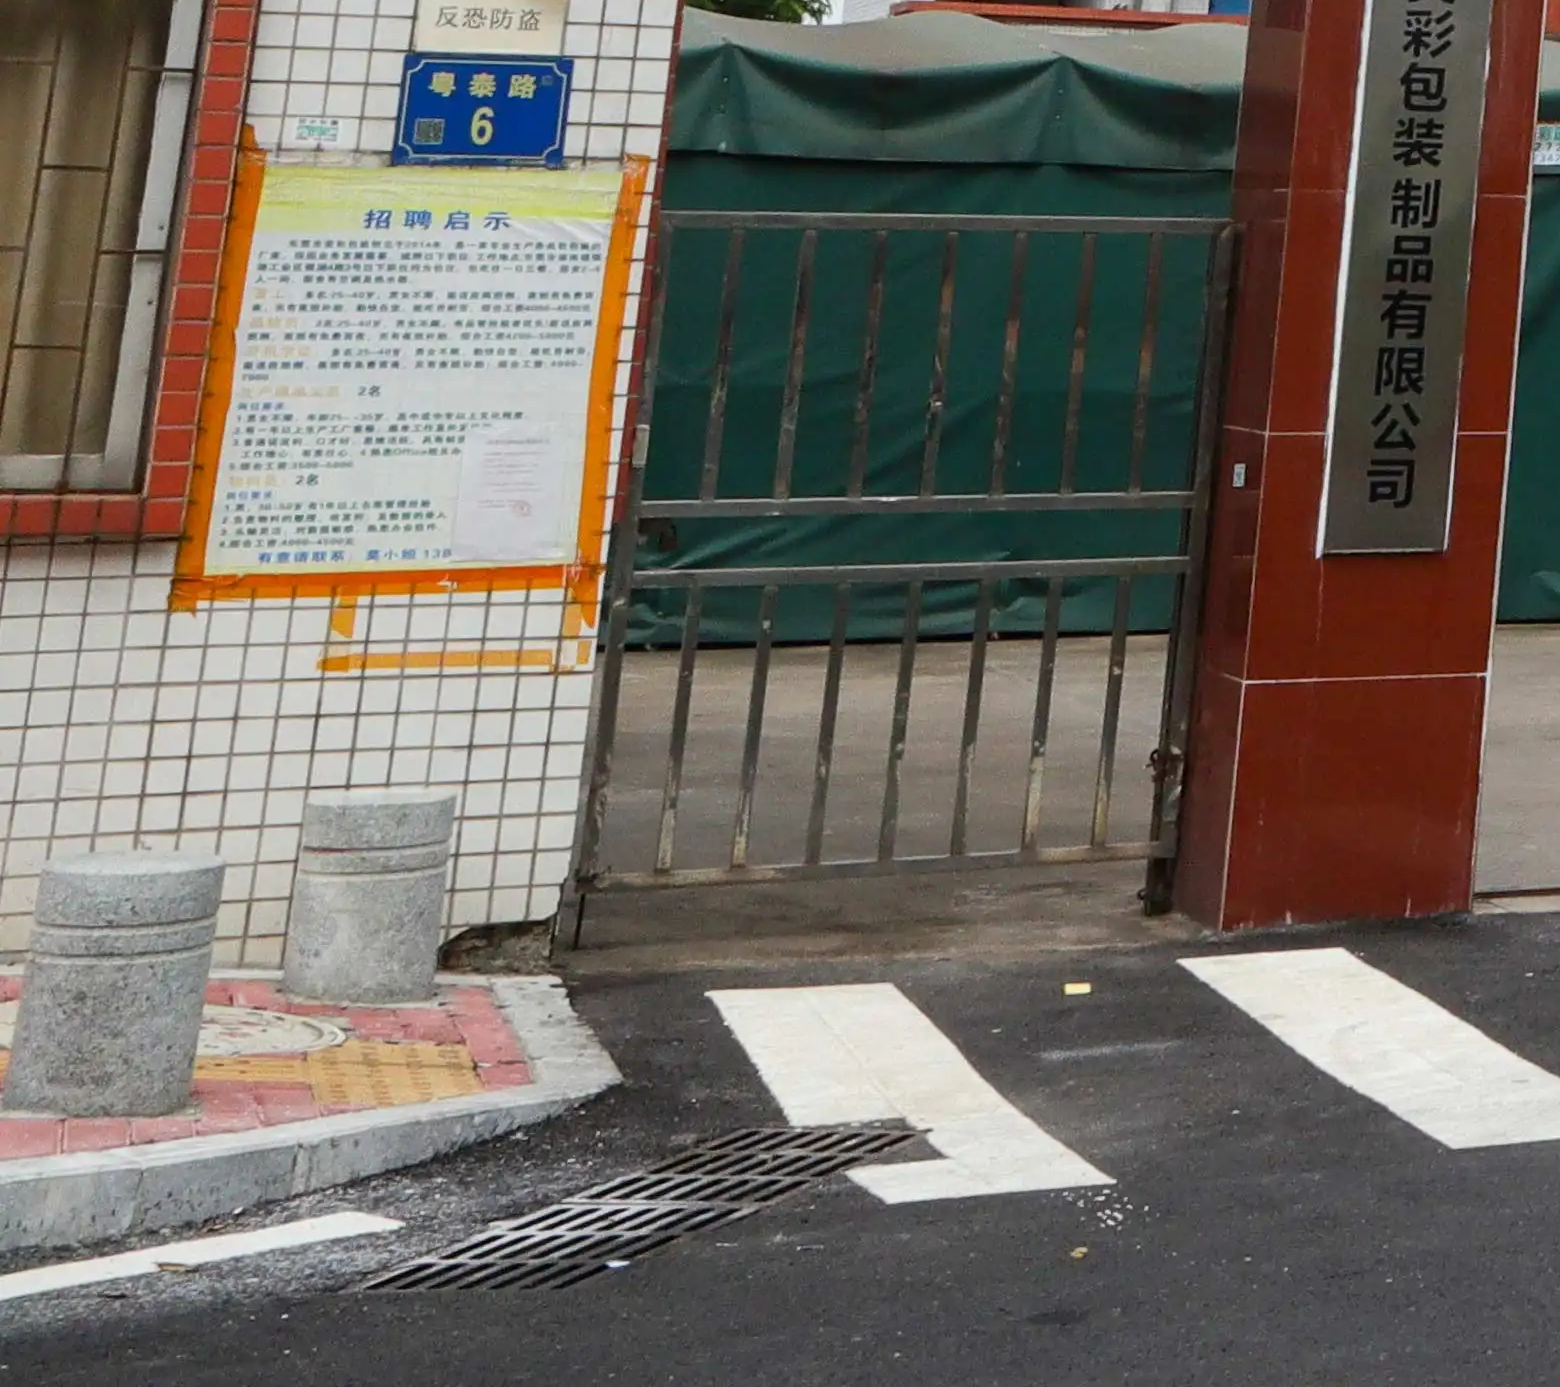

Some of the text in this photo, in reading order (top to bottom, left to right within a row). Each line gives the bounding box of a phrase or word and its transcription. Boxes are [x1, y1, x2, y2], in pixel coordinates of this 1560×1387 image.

[436, 6, 542, 31] 反恐防盗
[428, 72, 537, 99] 粤泰路
[470, 107, 495, 145] 6
[363, 209, 511, 231] 招聘启示
